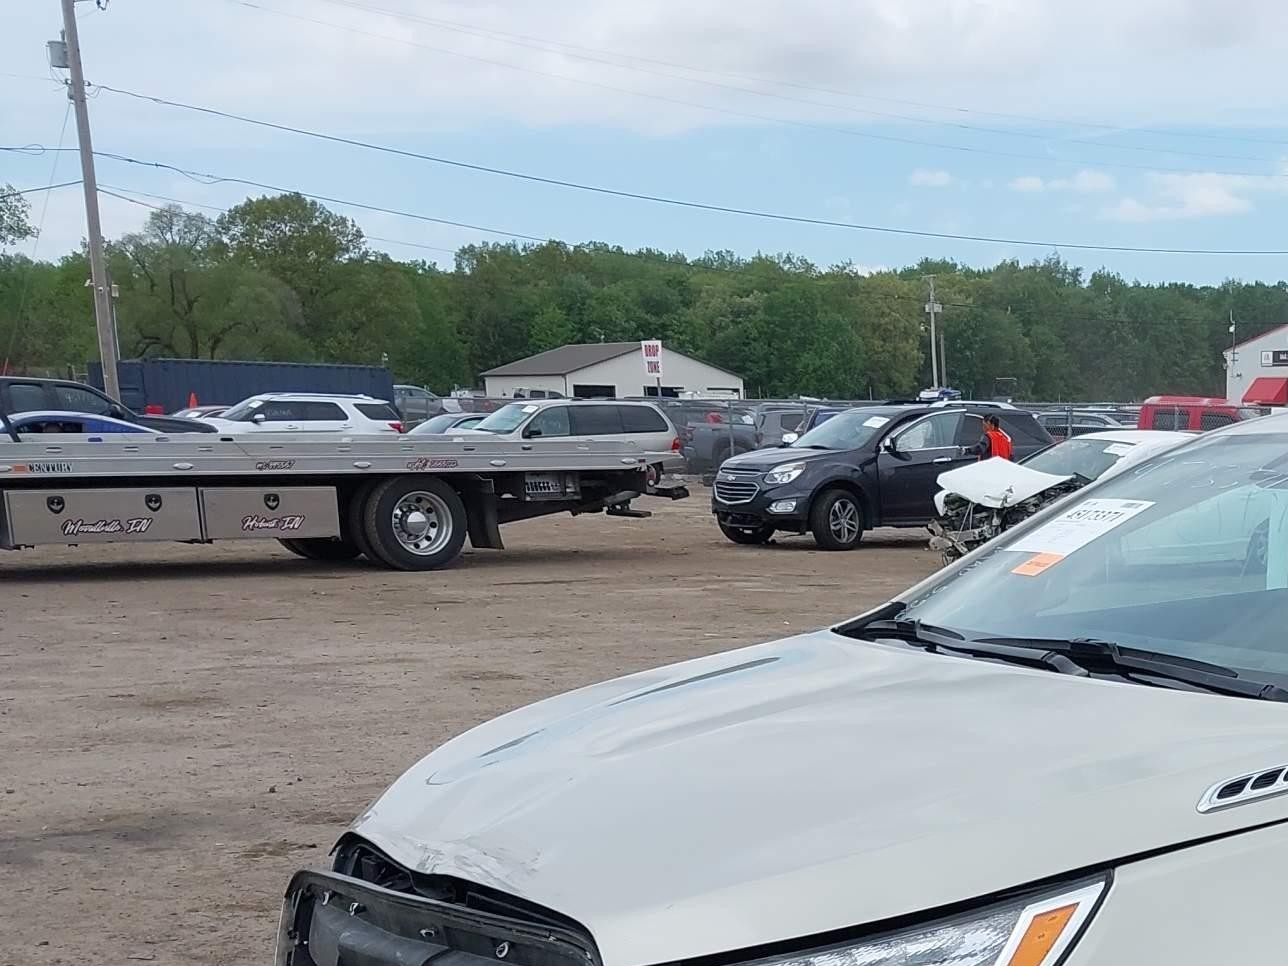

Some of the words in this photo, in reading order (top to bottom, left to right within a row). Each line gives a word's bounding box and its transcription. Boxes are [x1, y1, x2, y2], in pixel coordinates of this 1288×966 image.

[644, 344, 659, 357] DROP
[647, 361, 660, 373] ZONE
[28, 463, 73, 473] CENTURY
[126, 517, 153, 534] IN
[280, 514, 305, 531] IN
